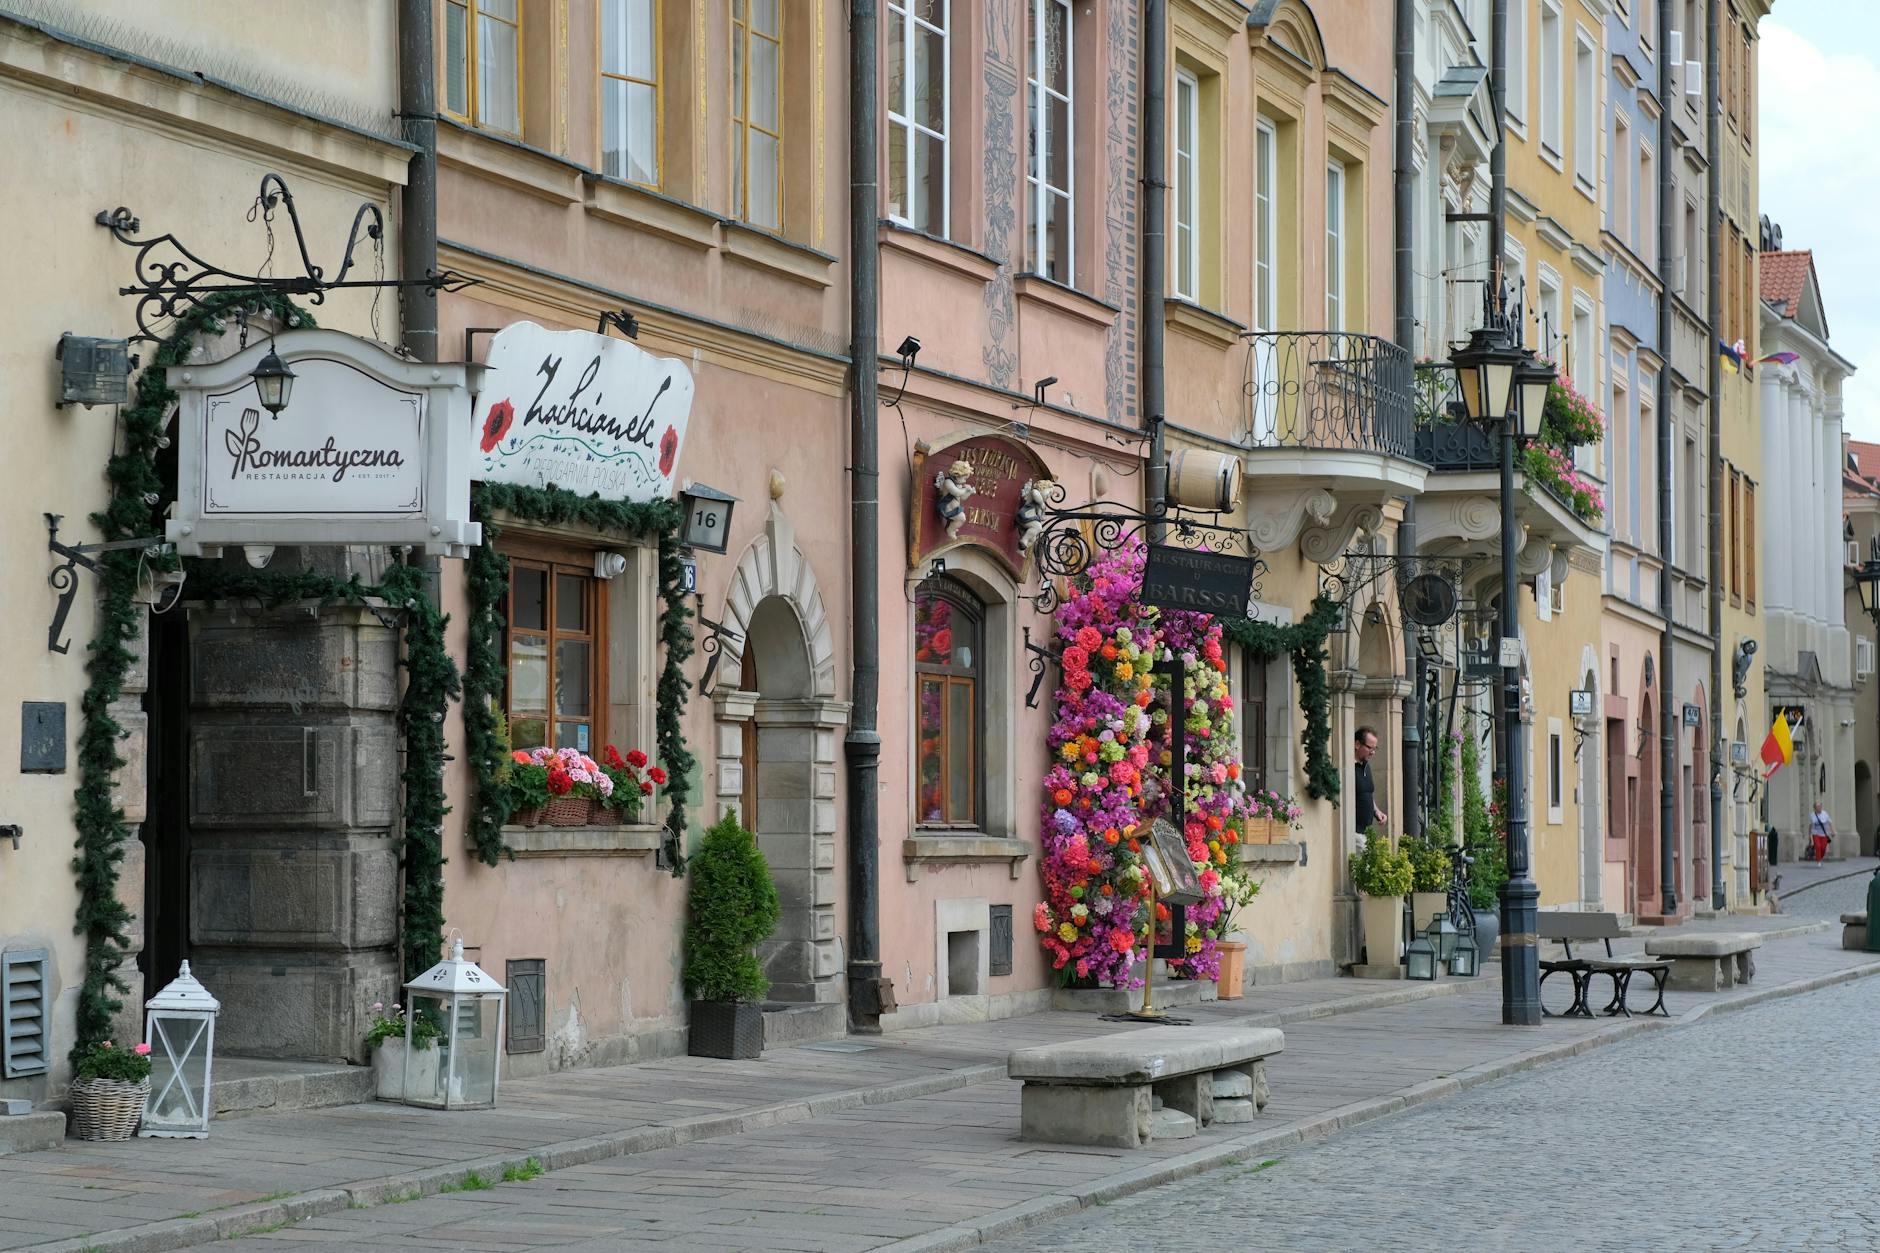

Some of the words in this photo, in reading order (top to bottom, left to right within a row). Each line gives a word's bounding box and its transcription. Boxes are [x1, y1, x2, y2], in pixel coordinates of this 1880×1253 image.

[240, 436, 404, 483] Romantyczna
[592, 467, 626, 492] POLSKA
[696, 510, 717, 528] 16
[684, 565, 693, 588] 16
[1153, 553, 1248, 577] RESTAURACJA
[1150, 583, 1240, 610] BARSSA
[1578, 692, 1585, 702] 8
